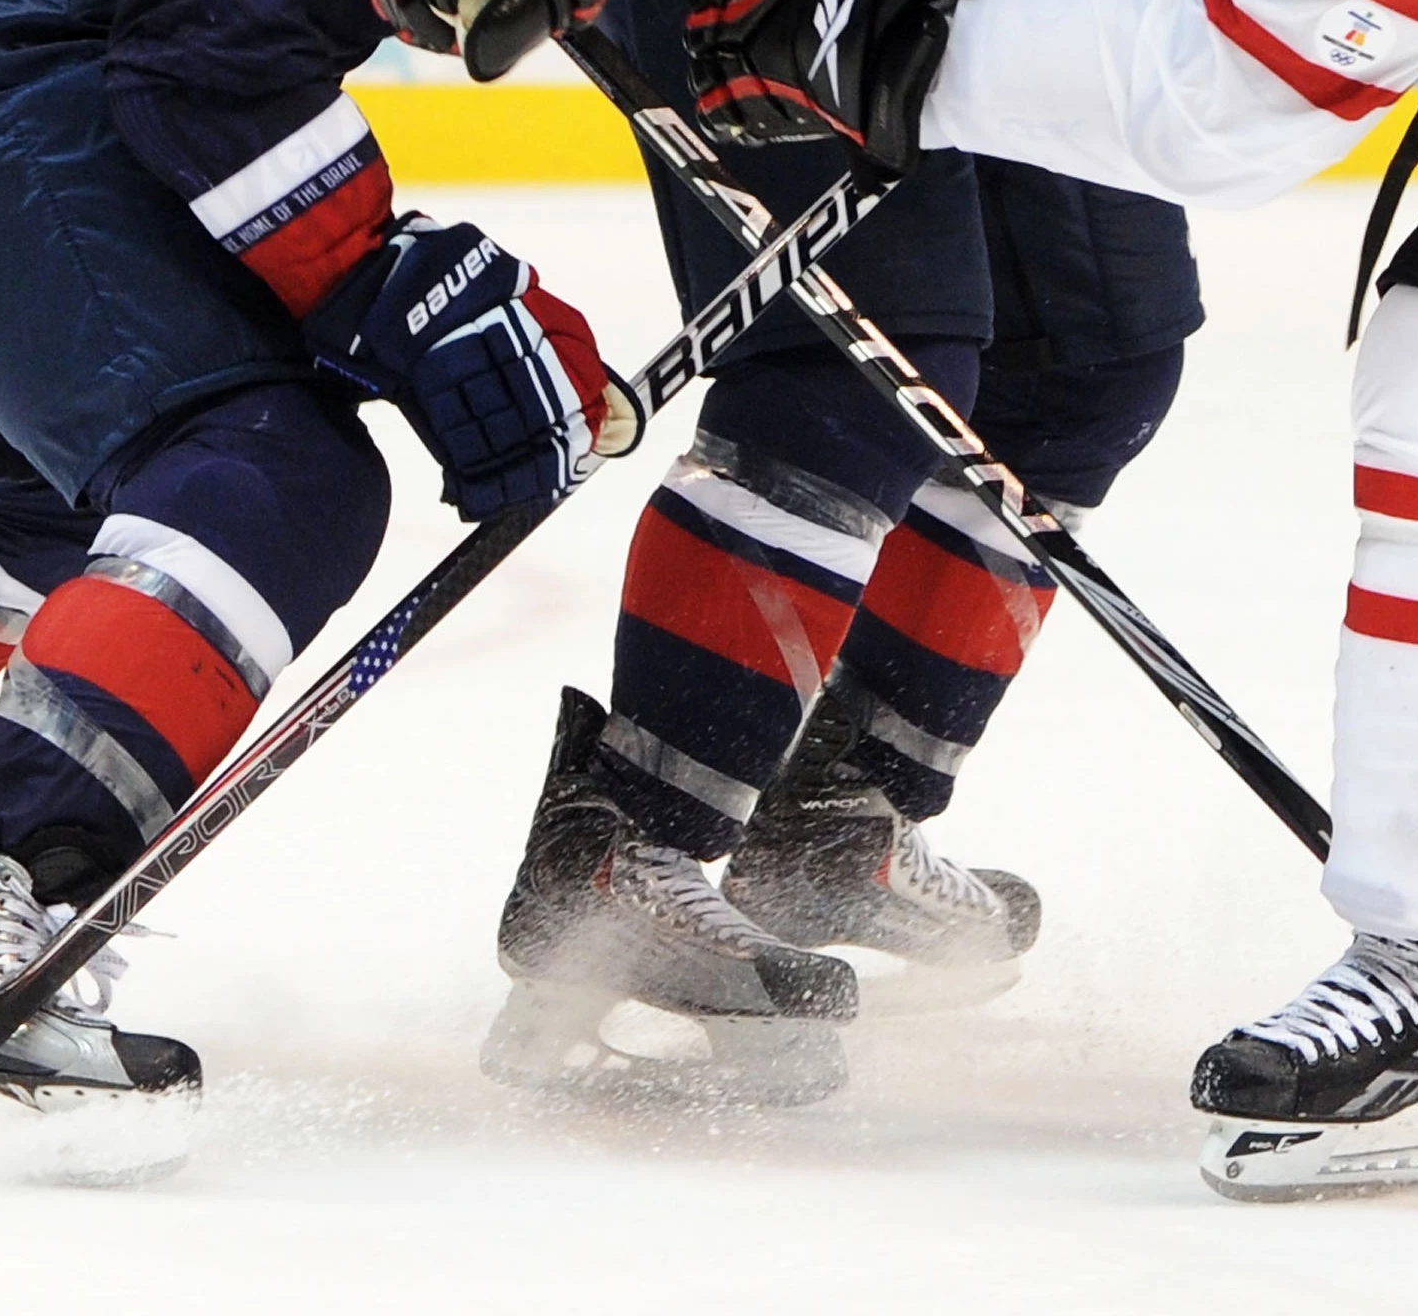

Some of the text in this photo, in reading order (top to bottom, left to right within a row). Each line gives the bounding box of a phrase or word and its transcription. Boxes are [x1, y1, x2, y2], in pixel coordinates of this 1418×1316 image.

[272, 204, 294, 222] OF
[292, 185, 325, 209] THE
[320, 151, 364, 189] BRAVE
[84, 756, 287, 934] VAPOR
